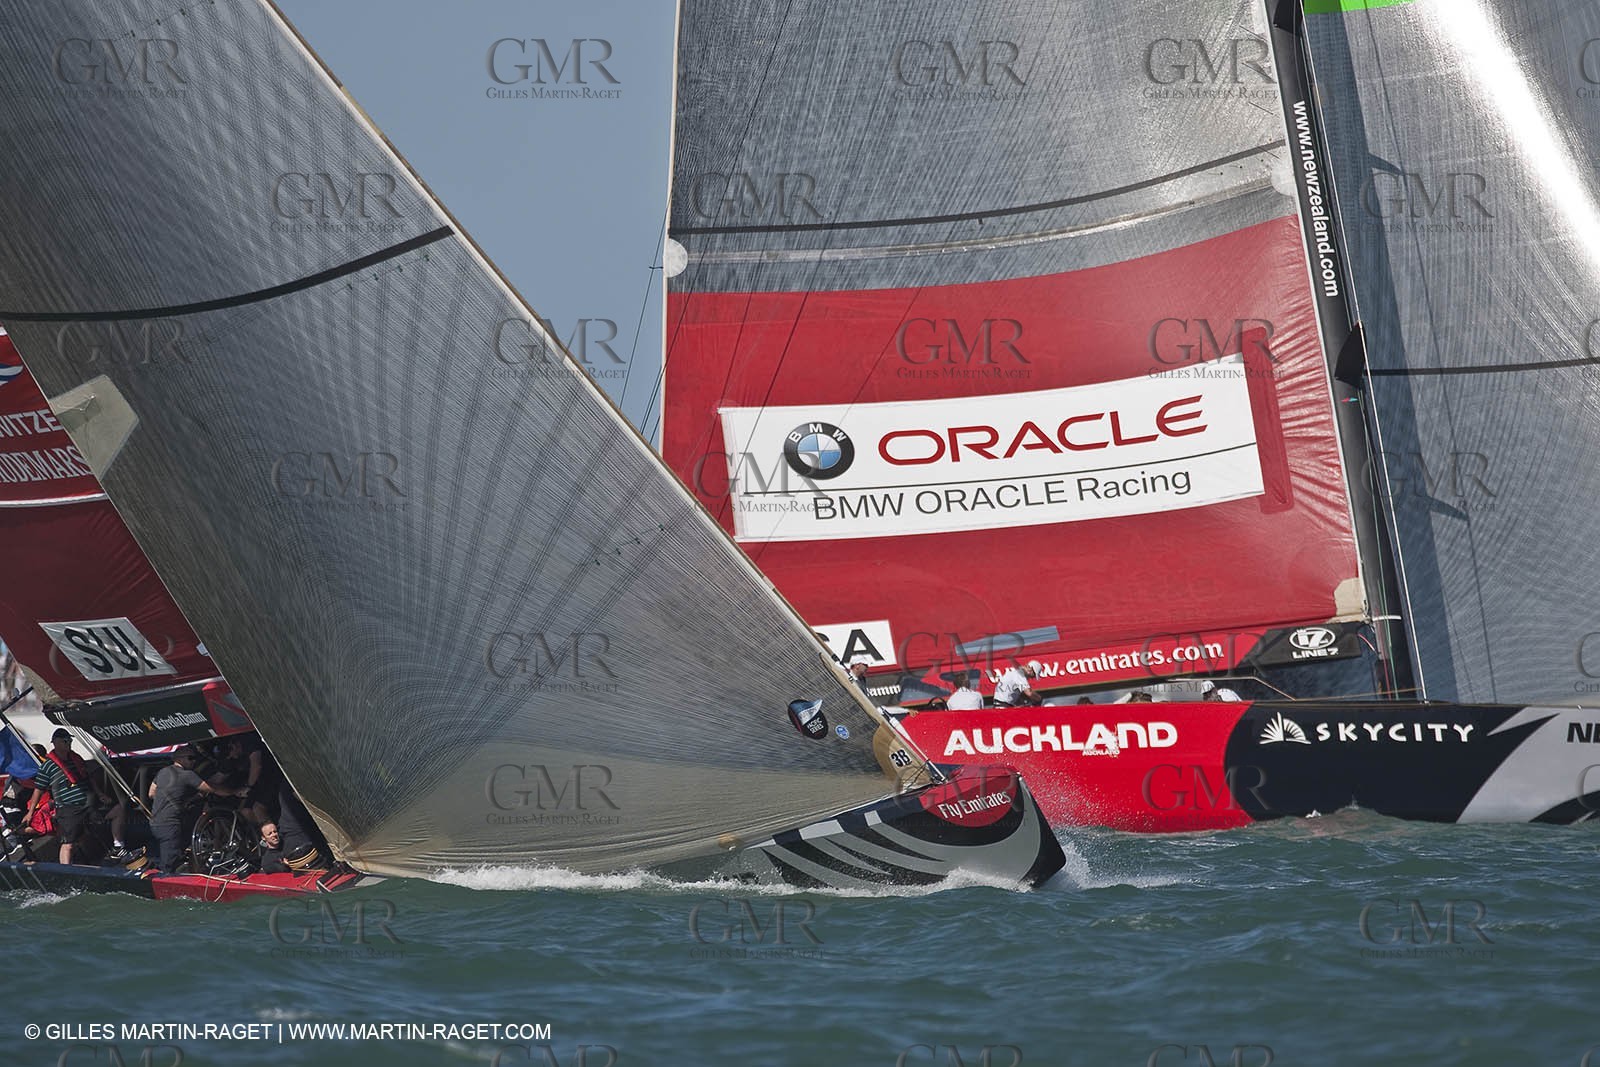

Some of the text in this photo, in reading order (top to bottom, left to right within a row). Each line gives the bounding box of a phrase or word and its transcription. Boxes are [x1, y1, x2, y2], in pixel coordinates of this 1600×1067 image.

[1292, 100, 1339, 298] www.newzealand.com
[790, 423, 847, 443] BMW
[878, 394, 1208, 466] ORACLE
[0, 445, 94, 484] UDEMARS
[813, 470, 1191, 521] BMW ORACLE Racing
[64, 625, 158, 674] SUI
[985, 642, 1225, 684] ww.emirates.com
[866, 684, 901, 697] amm
[105, 722, 144, 737] TOYOTA
[807, 717, 823, 729] PACIFIC
[810, 723, 825, 734] SERIES
[943, 722, 1178, 756] AUCKLAND
[1316, 722, 1475, 743] SKYCITY
[938, 802, 963, 820] Fly
[959, 788, 1012, 815] Emirates
